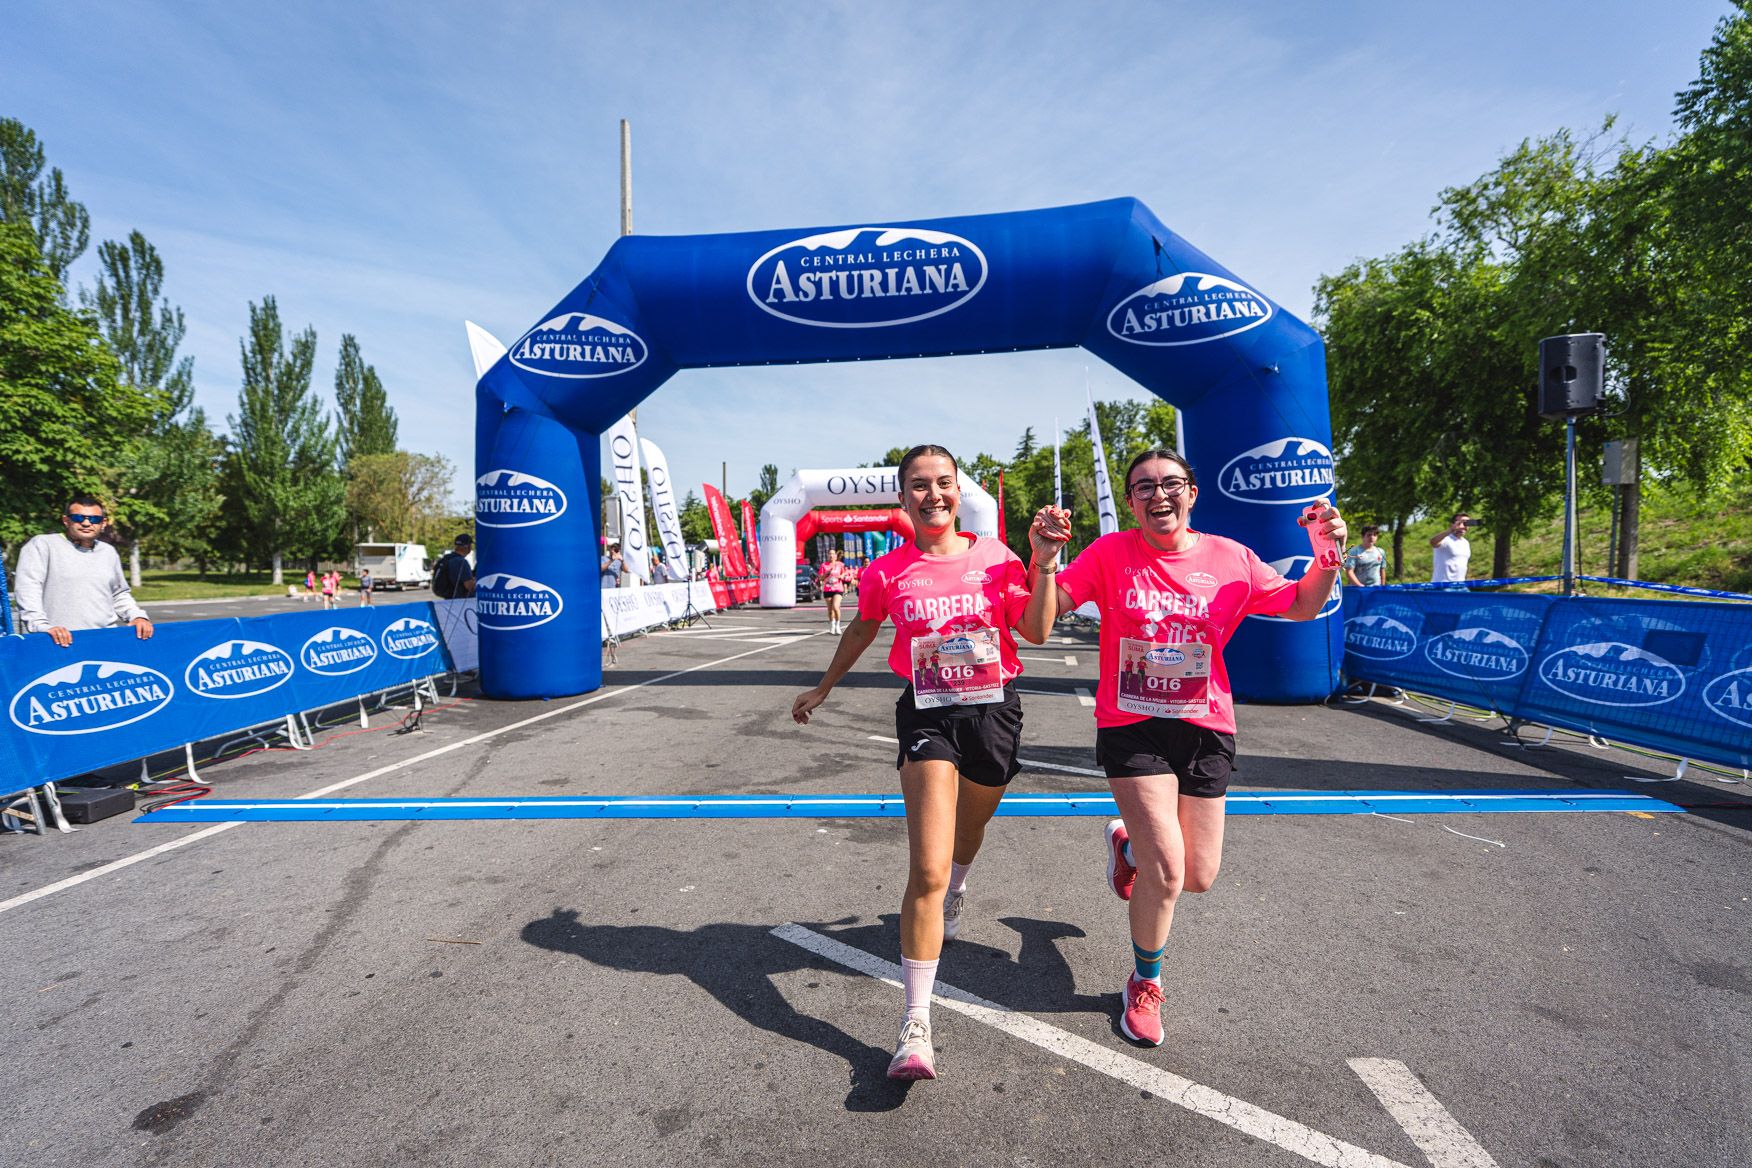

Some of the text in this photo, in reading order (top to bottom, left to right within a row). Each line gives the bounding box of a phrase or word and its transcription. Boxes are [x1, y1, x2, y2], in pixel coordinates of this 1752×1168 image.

[800, 247, 961, 267] CENTRAL LECHERA
[766, 260, 970, 303] ASTURIANA
[1144, 291, 1253, 310] CENTRAL LECHERA
[1121, 300, 1265, 335] ASTURIANA
[514, 338, 637, 363] ASTURIANA
[582, 335, 631, 344] LECHERA
[1250, 460, 1298, 471] CENTRAL
[828, 474, 897, 495] OYSH
[898, 578, 933, 590] OYSHO
[477, 600, 553, 616] STURIANA
[904, 593, 984, 622] CARRERA
[1126, 588, 1209, 617] CARRERA
[310, 645, 374, 668] ASTURIANA
[1431, 641, 1517, 672] ASTURIANA
[198, 660, 289, 691] ASTURIANA
[941, 666, 975, 680] 016
[1147, 676, 1181, 691] 016
[1547, 658, 1670, 697] ASTURIANA
[48, 675, 155, 699] CENTRAL LECHERA
[28, 683, 167, 726] ASTURIANA
[1126, 702, 1155, 712] OYSHO
